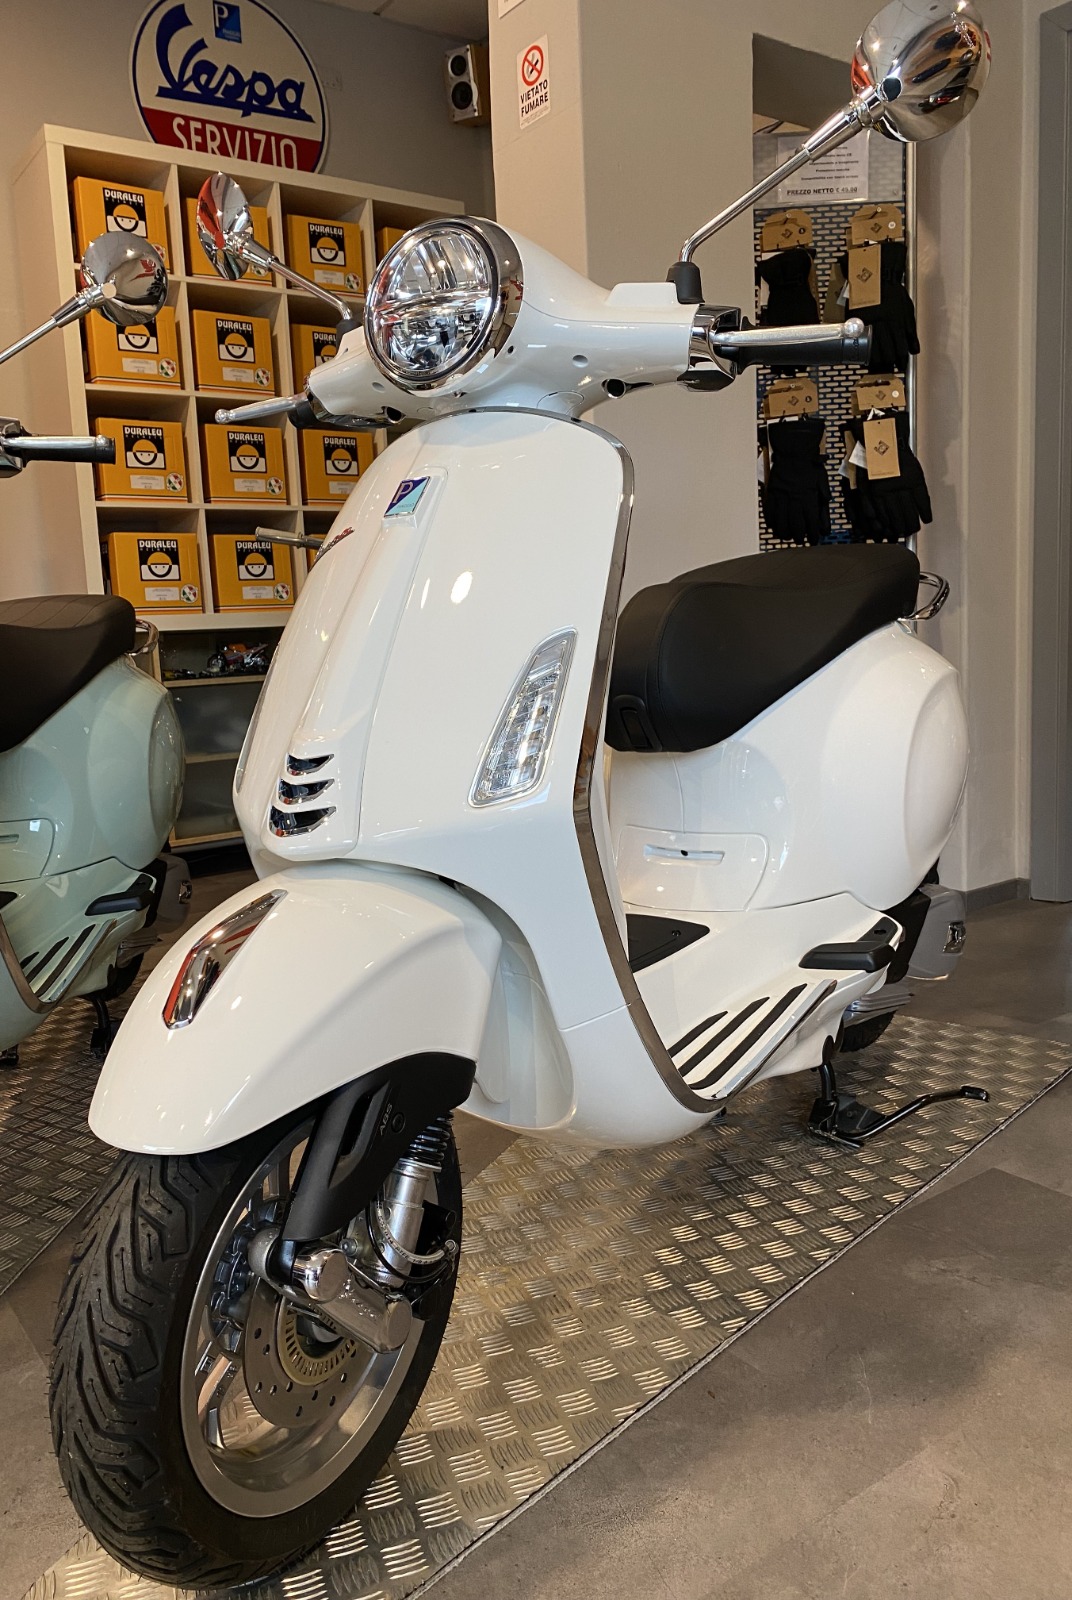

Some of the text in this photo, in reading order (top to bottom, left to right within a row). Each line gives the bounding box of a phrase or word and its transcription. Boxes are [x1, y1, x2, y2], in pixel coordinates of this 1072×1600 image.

[156, 4, 316, 123] Vespa
[520, 79, 548, 104] VIETATO
[521, 91, 549, 117] FUMARE
[172, 116, 298, 171] SERVIZIO
[104, 189, 144, 203] DURALEU
[786, 188, 812, 196] PREZZO
[812, 187, 834, 195] NETTO
[309, 224, 343, 235] DURALEU
[217, 320, 252, 331] DURALEU
[314, 332, 337, 341] DURAL
[124, 426, 162, 436] DURALEU
[228, 432, 264, 441] DURALEU
[324, 437, 356, 445] DURALEU
[139, 540, 177, 548] DURALEU
[236, 541, 271, 549] DURALEU
[380, 1103, 393, 1136] ABS
